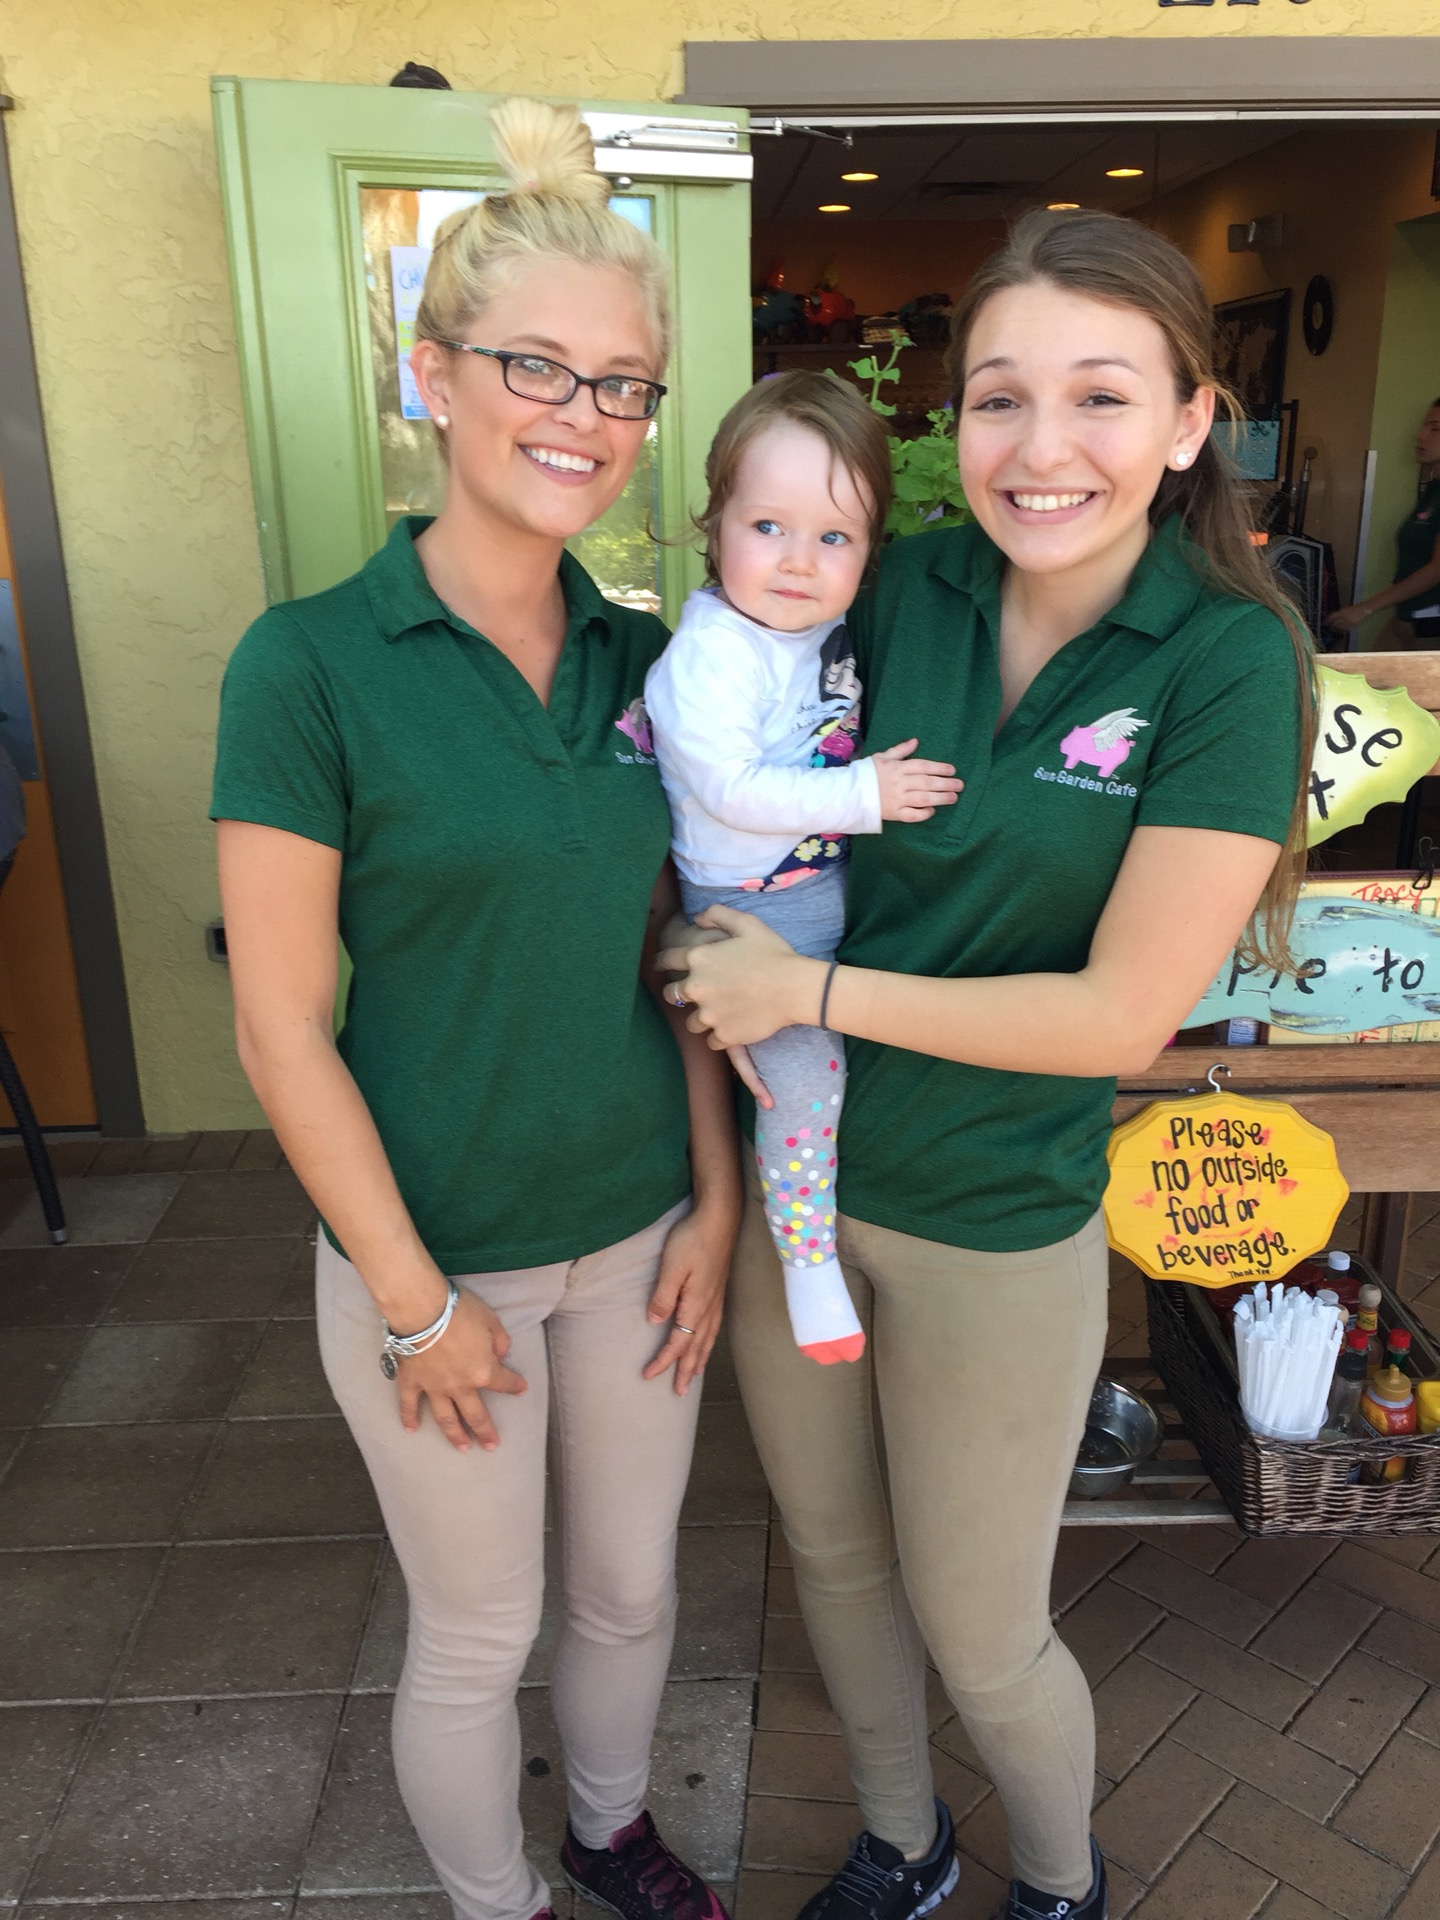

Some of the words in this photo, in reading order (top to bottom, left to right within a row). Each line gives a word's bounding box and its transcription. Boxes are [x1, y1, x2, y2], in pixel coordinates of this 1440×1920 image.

[1056, 770, 1104, 793] Garden
[1105, 781, 1138, 798] Cafe
[1351, 882, 1427, 914] TRACY
[1373, 947, 1425, 993] to
[1170, 1117, 1264, 1149] Please
[1151, 1159, 1190, 1191] no
[1202, 1152, 1288, 1188] outside
[1165, 1194, 1230, 1236] food
[1236, 1198, 1260, 1222] or
[1156, 1231, 1296, 1271] beverage.
